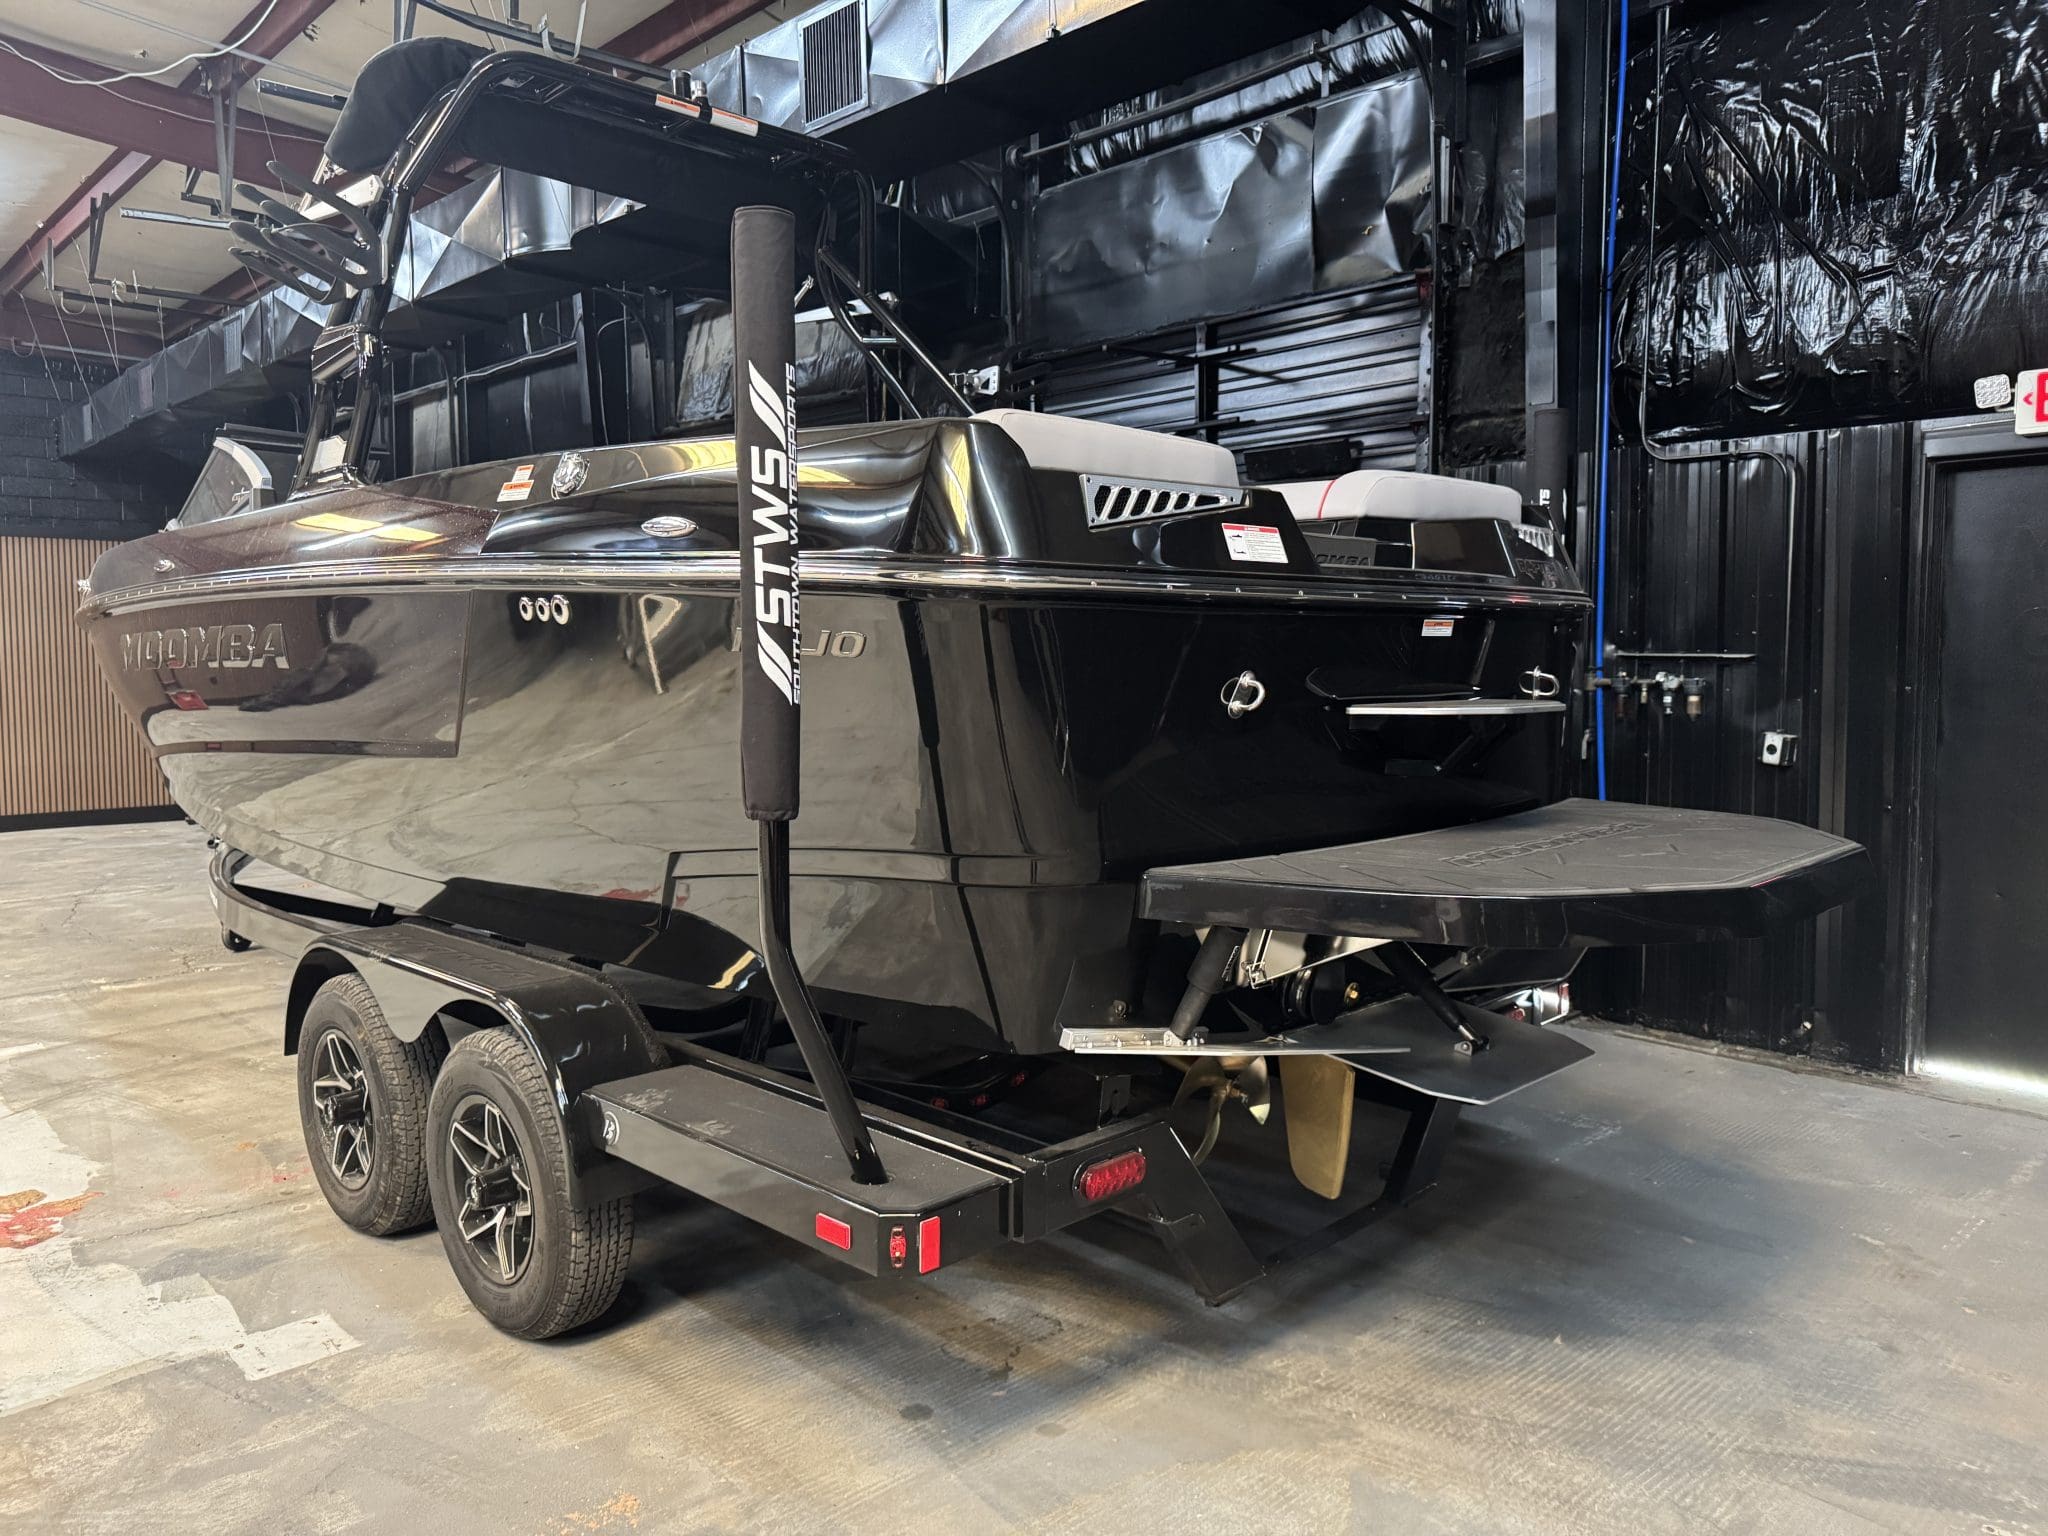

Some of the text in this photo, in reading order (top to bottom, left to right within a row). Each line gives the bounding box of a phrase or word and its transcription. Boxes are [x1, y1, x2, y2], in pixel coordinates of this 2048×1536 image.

[751, 446, 793, 627] STWS
[785, 362, 801, 705] SOUTHTOWN WATERSPORTS
[120, 623, 290, 671] MOOMBA
